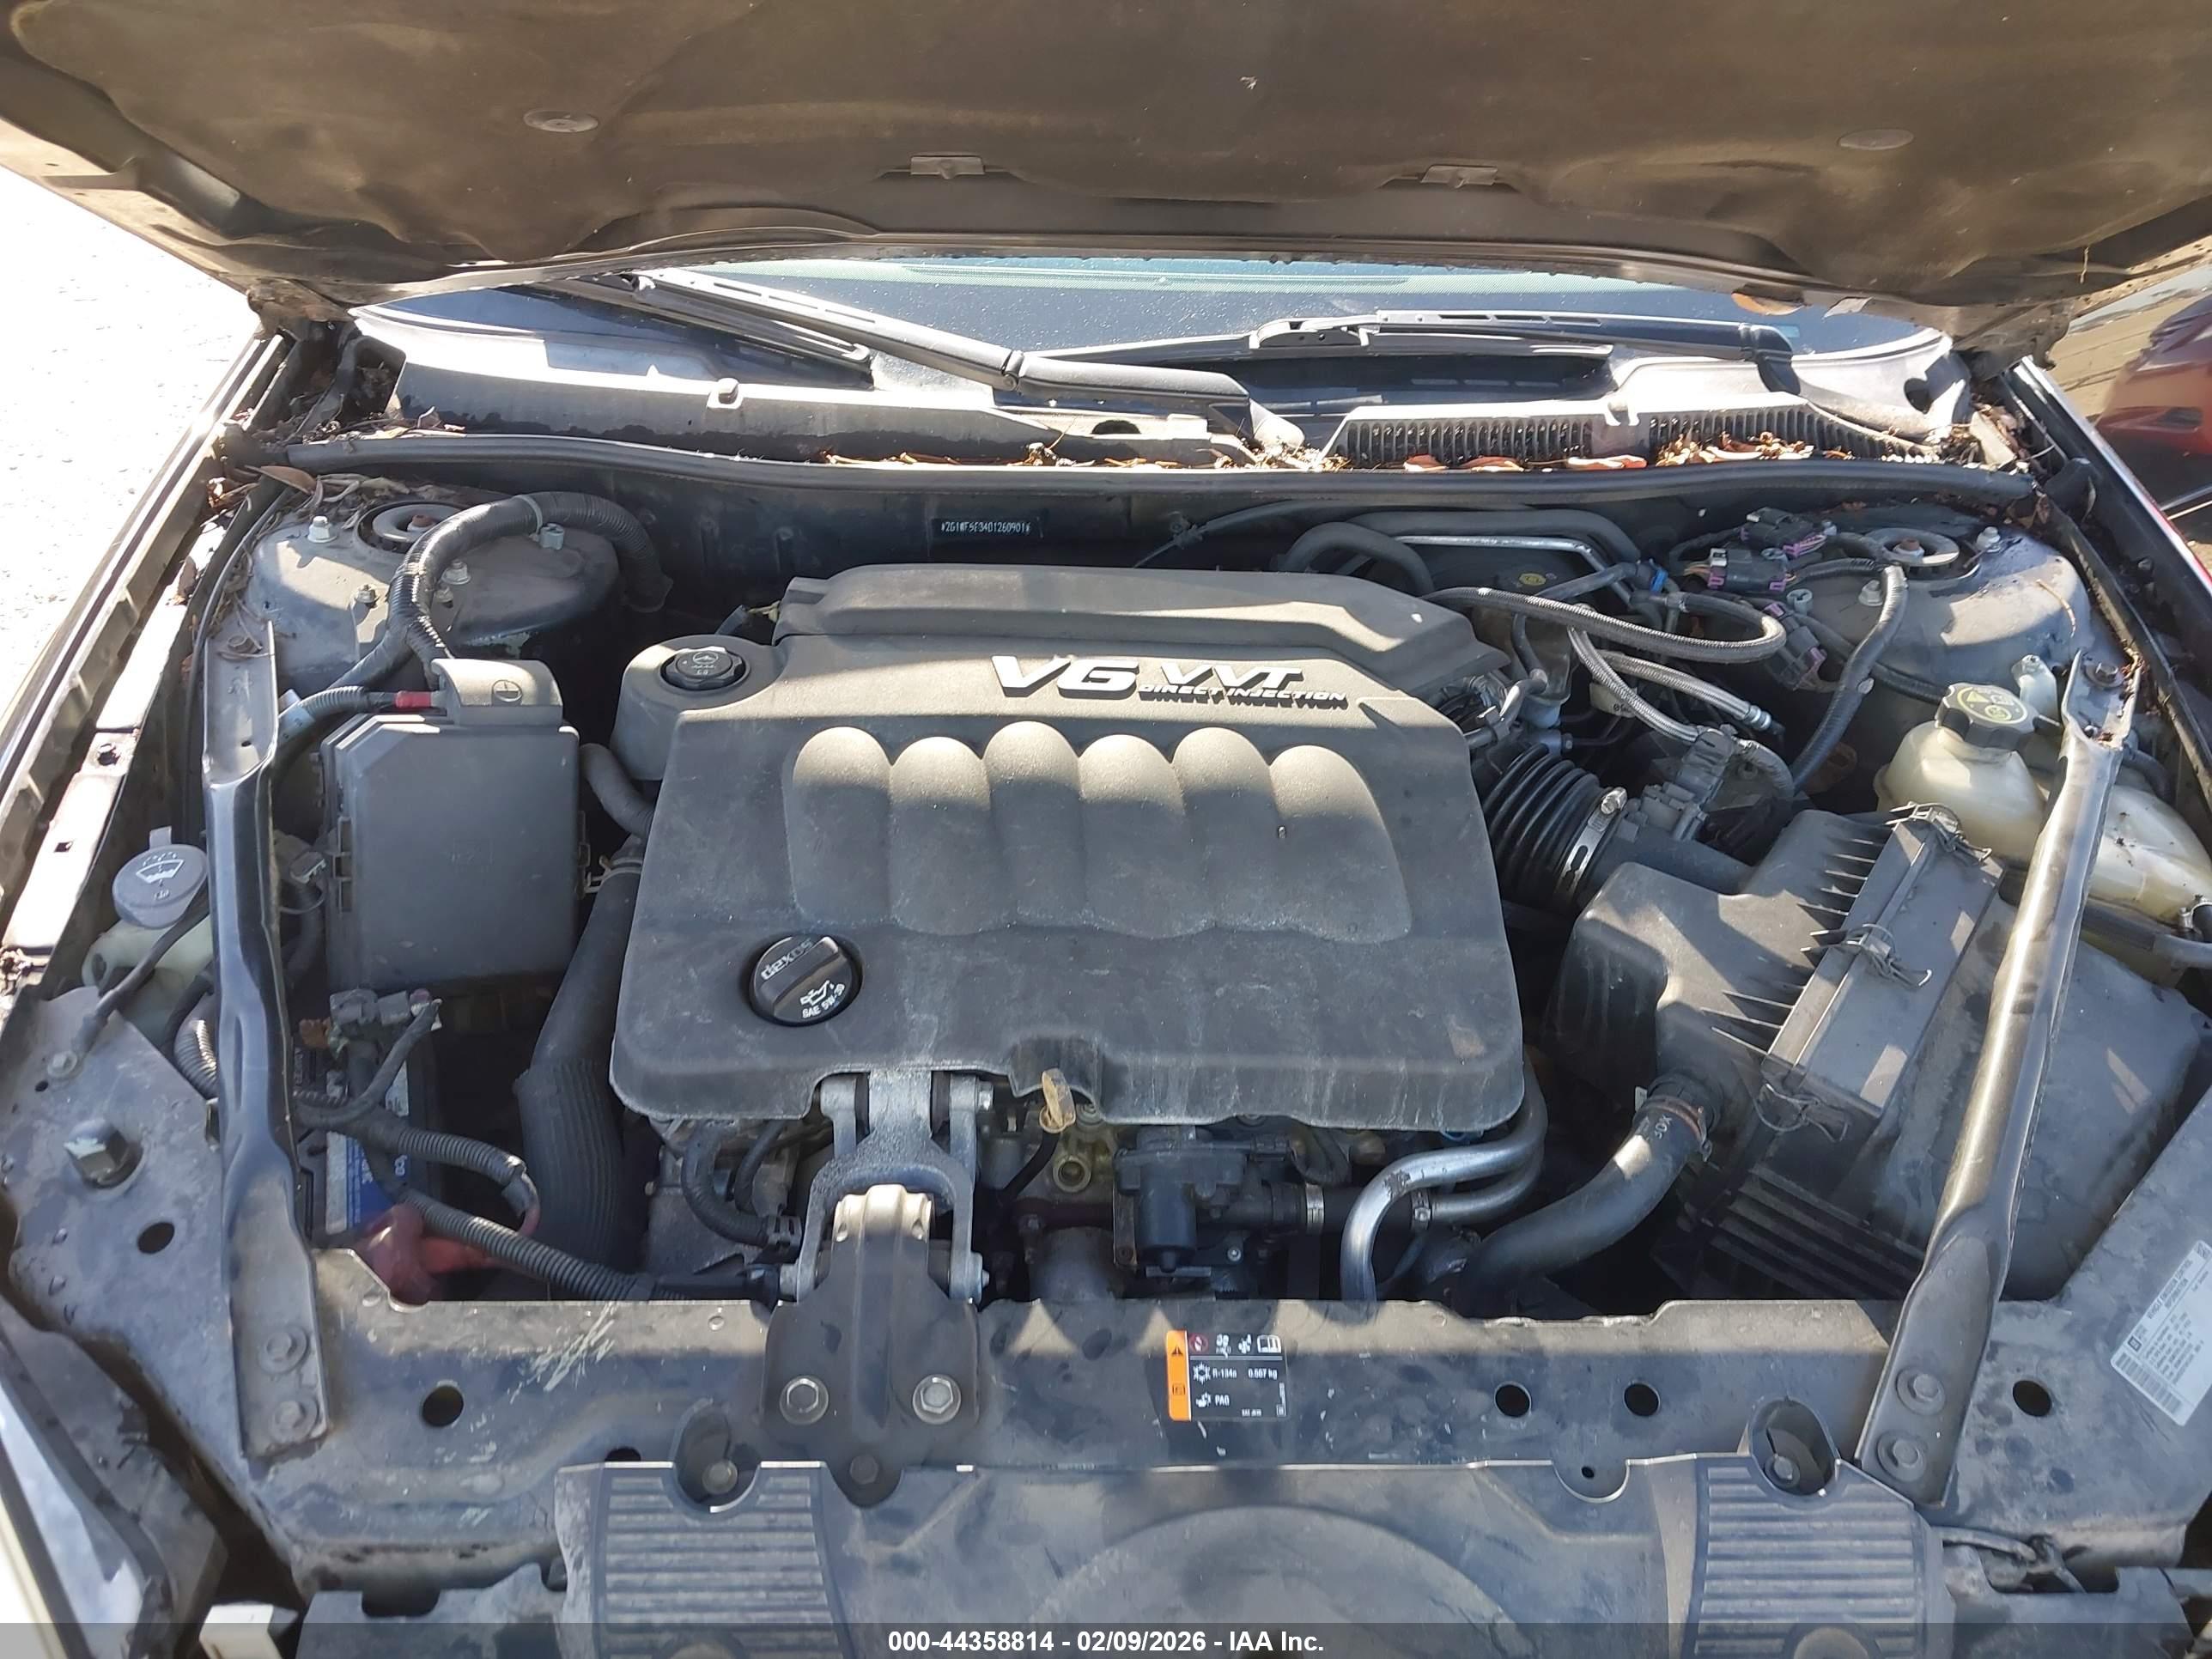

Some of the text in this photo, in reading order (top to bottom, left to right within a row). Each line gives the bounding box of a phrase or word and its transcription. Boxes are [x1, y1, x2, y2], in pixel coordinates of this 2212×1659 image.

[991, 655, 1304, 697] V6 VVT
[1139, 684, 1347, 706] DIRECT INJECTION
[761, 938, 814, 980] dexos
[802, 984, 845, 1018] SAE 5W-30
